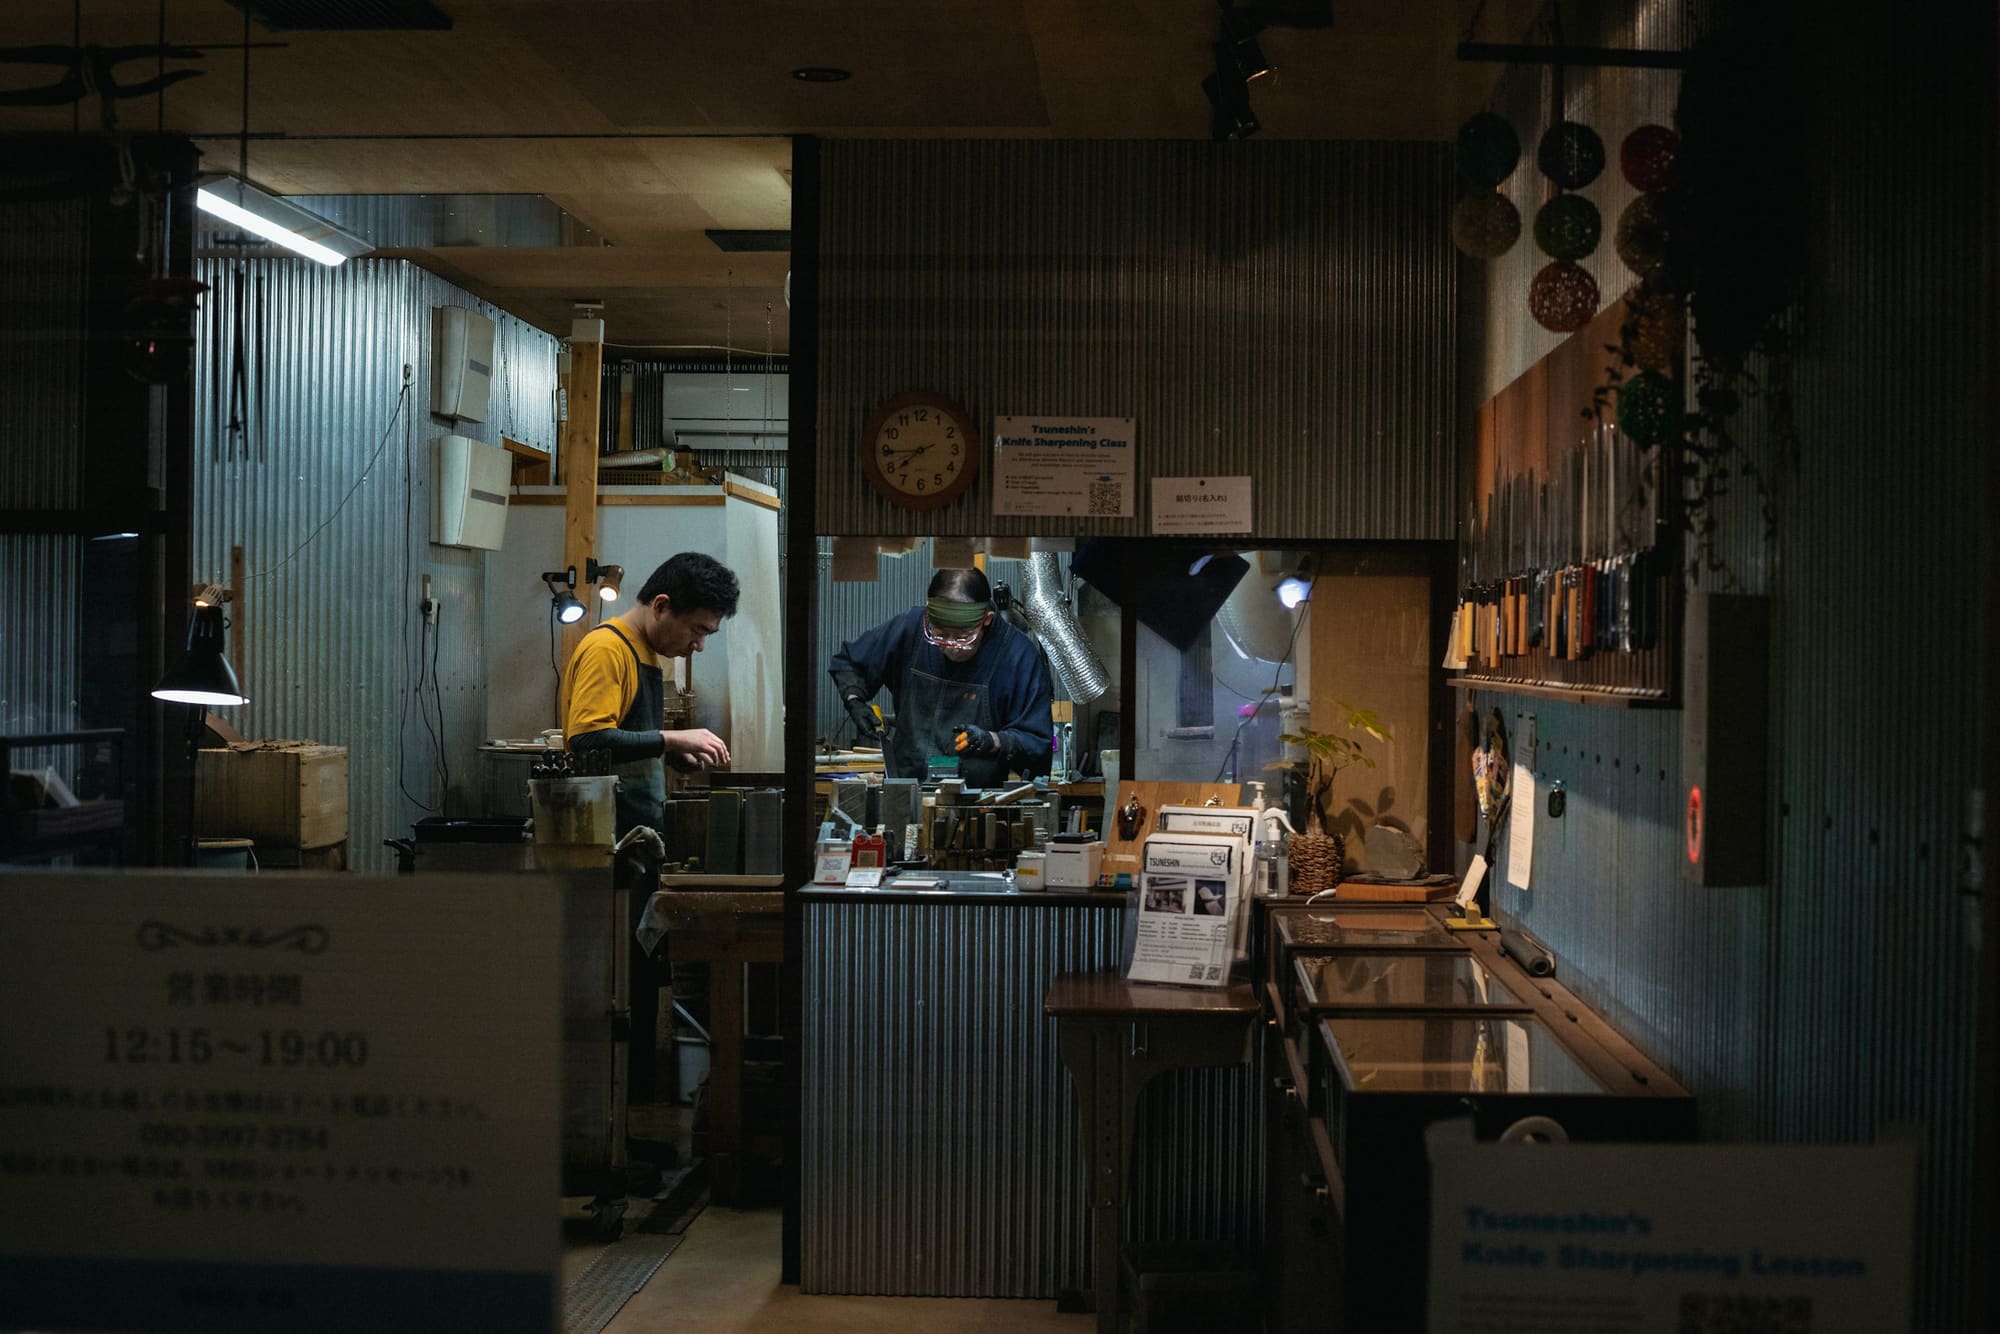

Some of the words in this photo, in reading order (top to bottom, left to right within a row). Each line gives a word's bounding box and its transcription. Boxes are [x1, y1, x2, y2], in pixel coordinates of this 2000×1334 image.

[899, 415, 908, 426] 11
[913, 409, 928, 421] 12
[885, 428, 898, 439] 10
[946, 426, 954, 438] 2
[1031, 425, 1096, 434] Tsuneshin's
[1002, 438, 1032, 446] Knife
[1035, 438, 1097, 449] Sharpening
[1100, 439, 1127, 447] Class
[951, 444, 959, 455] 3
[887, 462, 895, 473] 8
[946, 462, 954, 472] 4
[900, 474, 907, 485] 7
[917, 479, 925, 490] 6
[934, 474, 942, 485] 5
[1149, 857, 1181, 868] TSUNESHIN
[1463, 1205, 1653, 1235] Tsuneshin's
[1461, 1241, 1547, 1268] Knife
[1557, 1243, 1741, 1280] Sharpening
